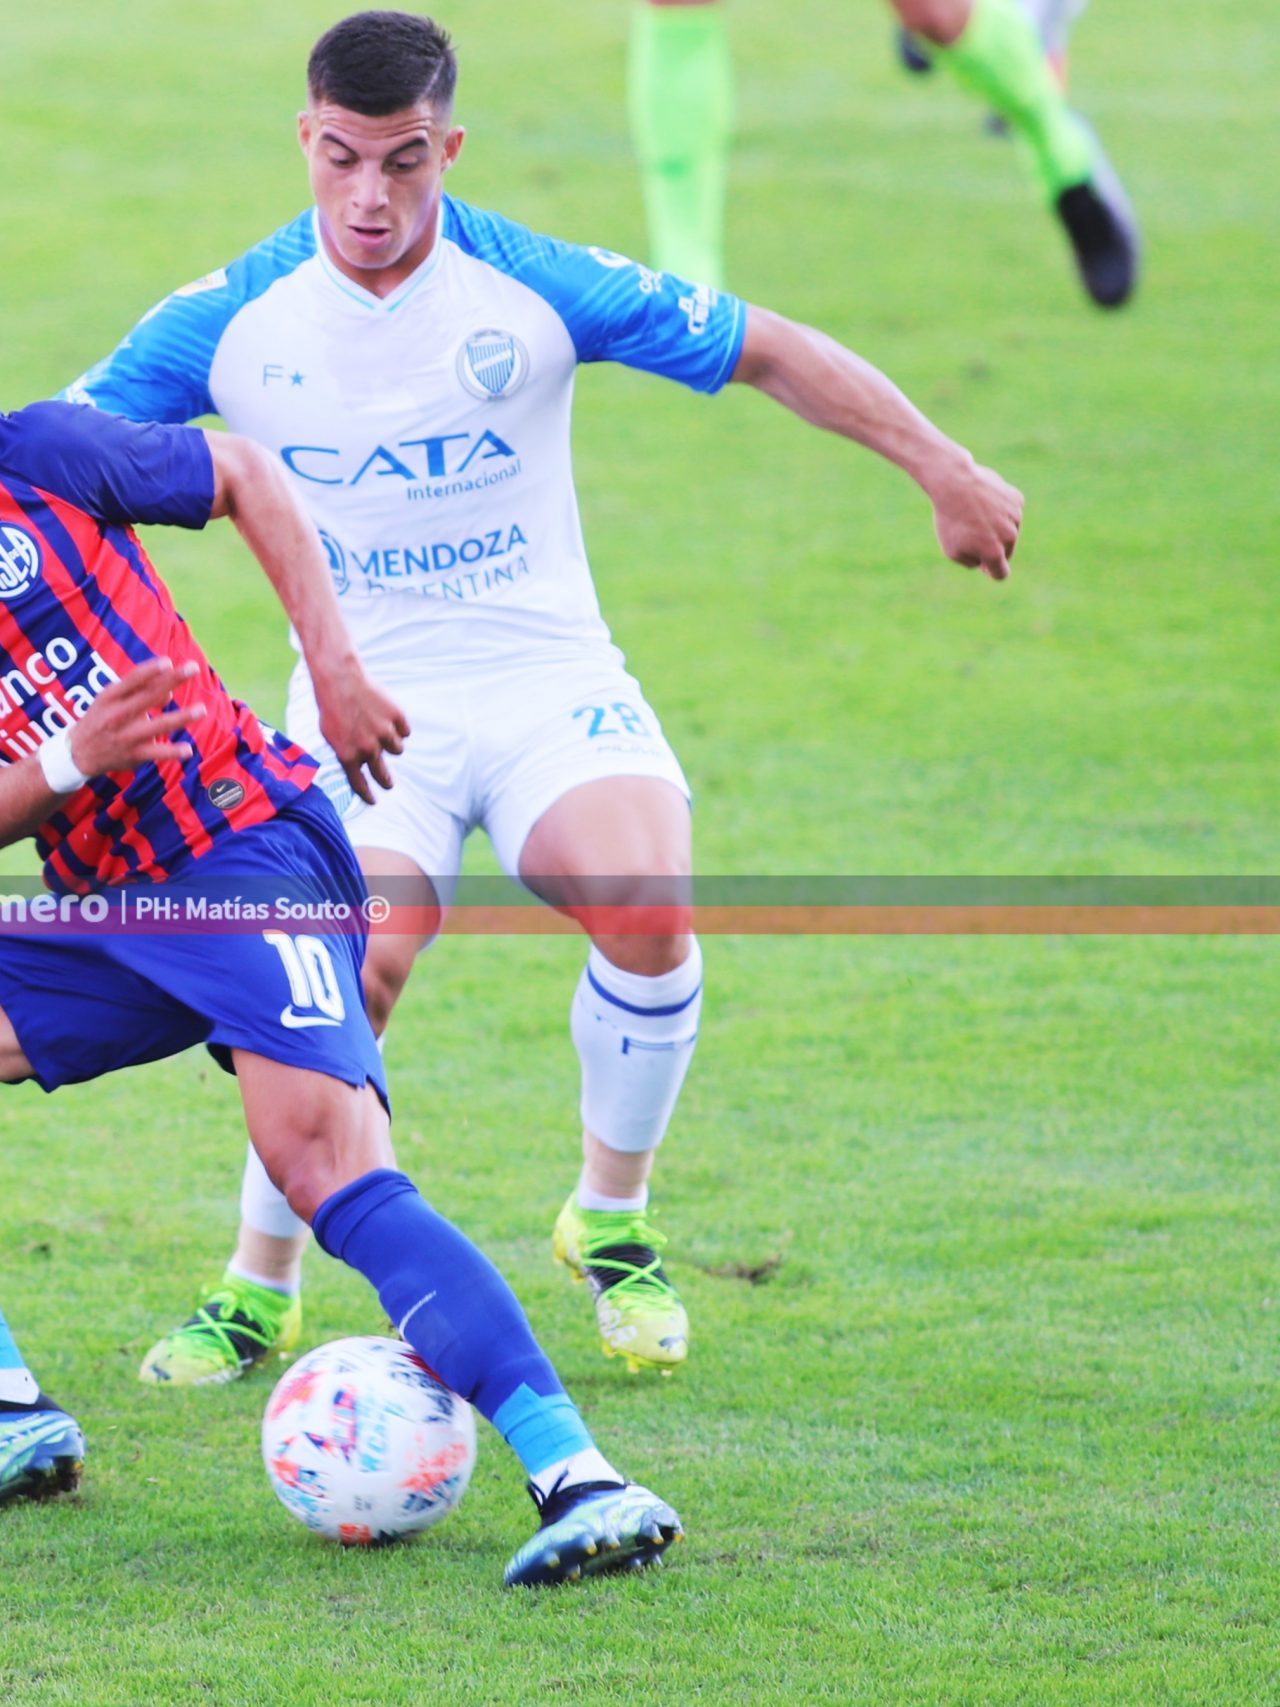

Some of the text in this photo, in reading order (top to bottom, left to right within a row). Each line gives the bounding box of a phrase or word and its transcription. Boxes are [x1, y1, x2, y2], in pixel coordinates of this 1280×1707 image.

[280, 429, 517, 487] CATA
[406, 458, 522, 502] Internacional
[349, 523, 529, 578] MENDOZA
[571, 702, 651, 739] 28
[261, 928, 346, 1022] 10
